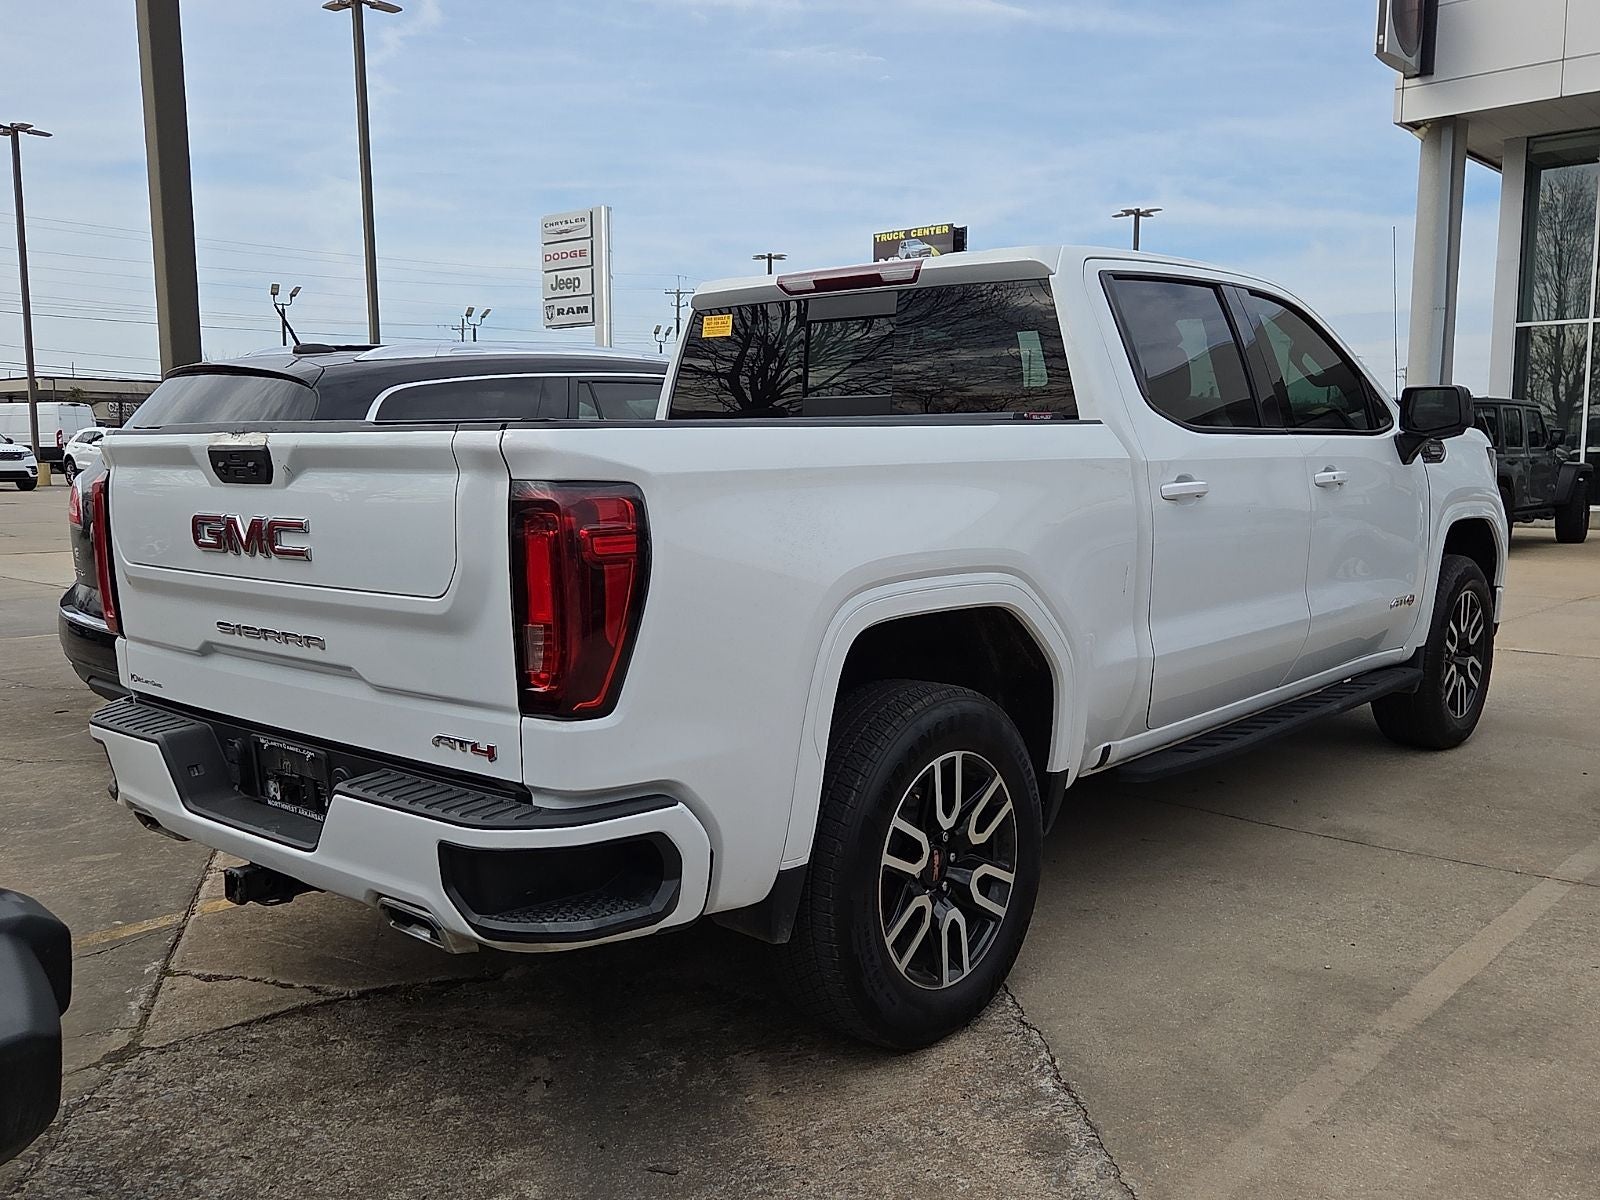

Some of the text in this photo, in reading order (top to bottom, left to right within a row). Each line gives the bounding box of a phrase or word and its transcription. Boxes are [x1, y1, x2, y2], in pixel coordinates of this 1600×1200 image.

[544, 217, 586, 228] CHRYSLER
[875, 225, 949, 242] TRUCK CENTER
[544, 249, 587, 262] DODGE
[550, 275, 581, 292] Jeep
[556, 305, 589, 316] RAM
[192, 511, 312, 561] GMC
[216, 620, 326, 650] SIERRA
[431, 732, 497, 763] AT4
